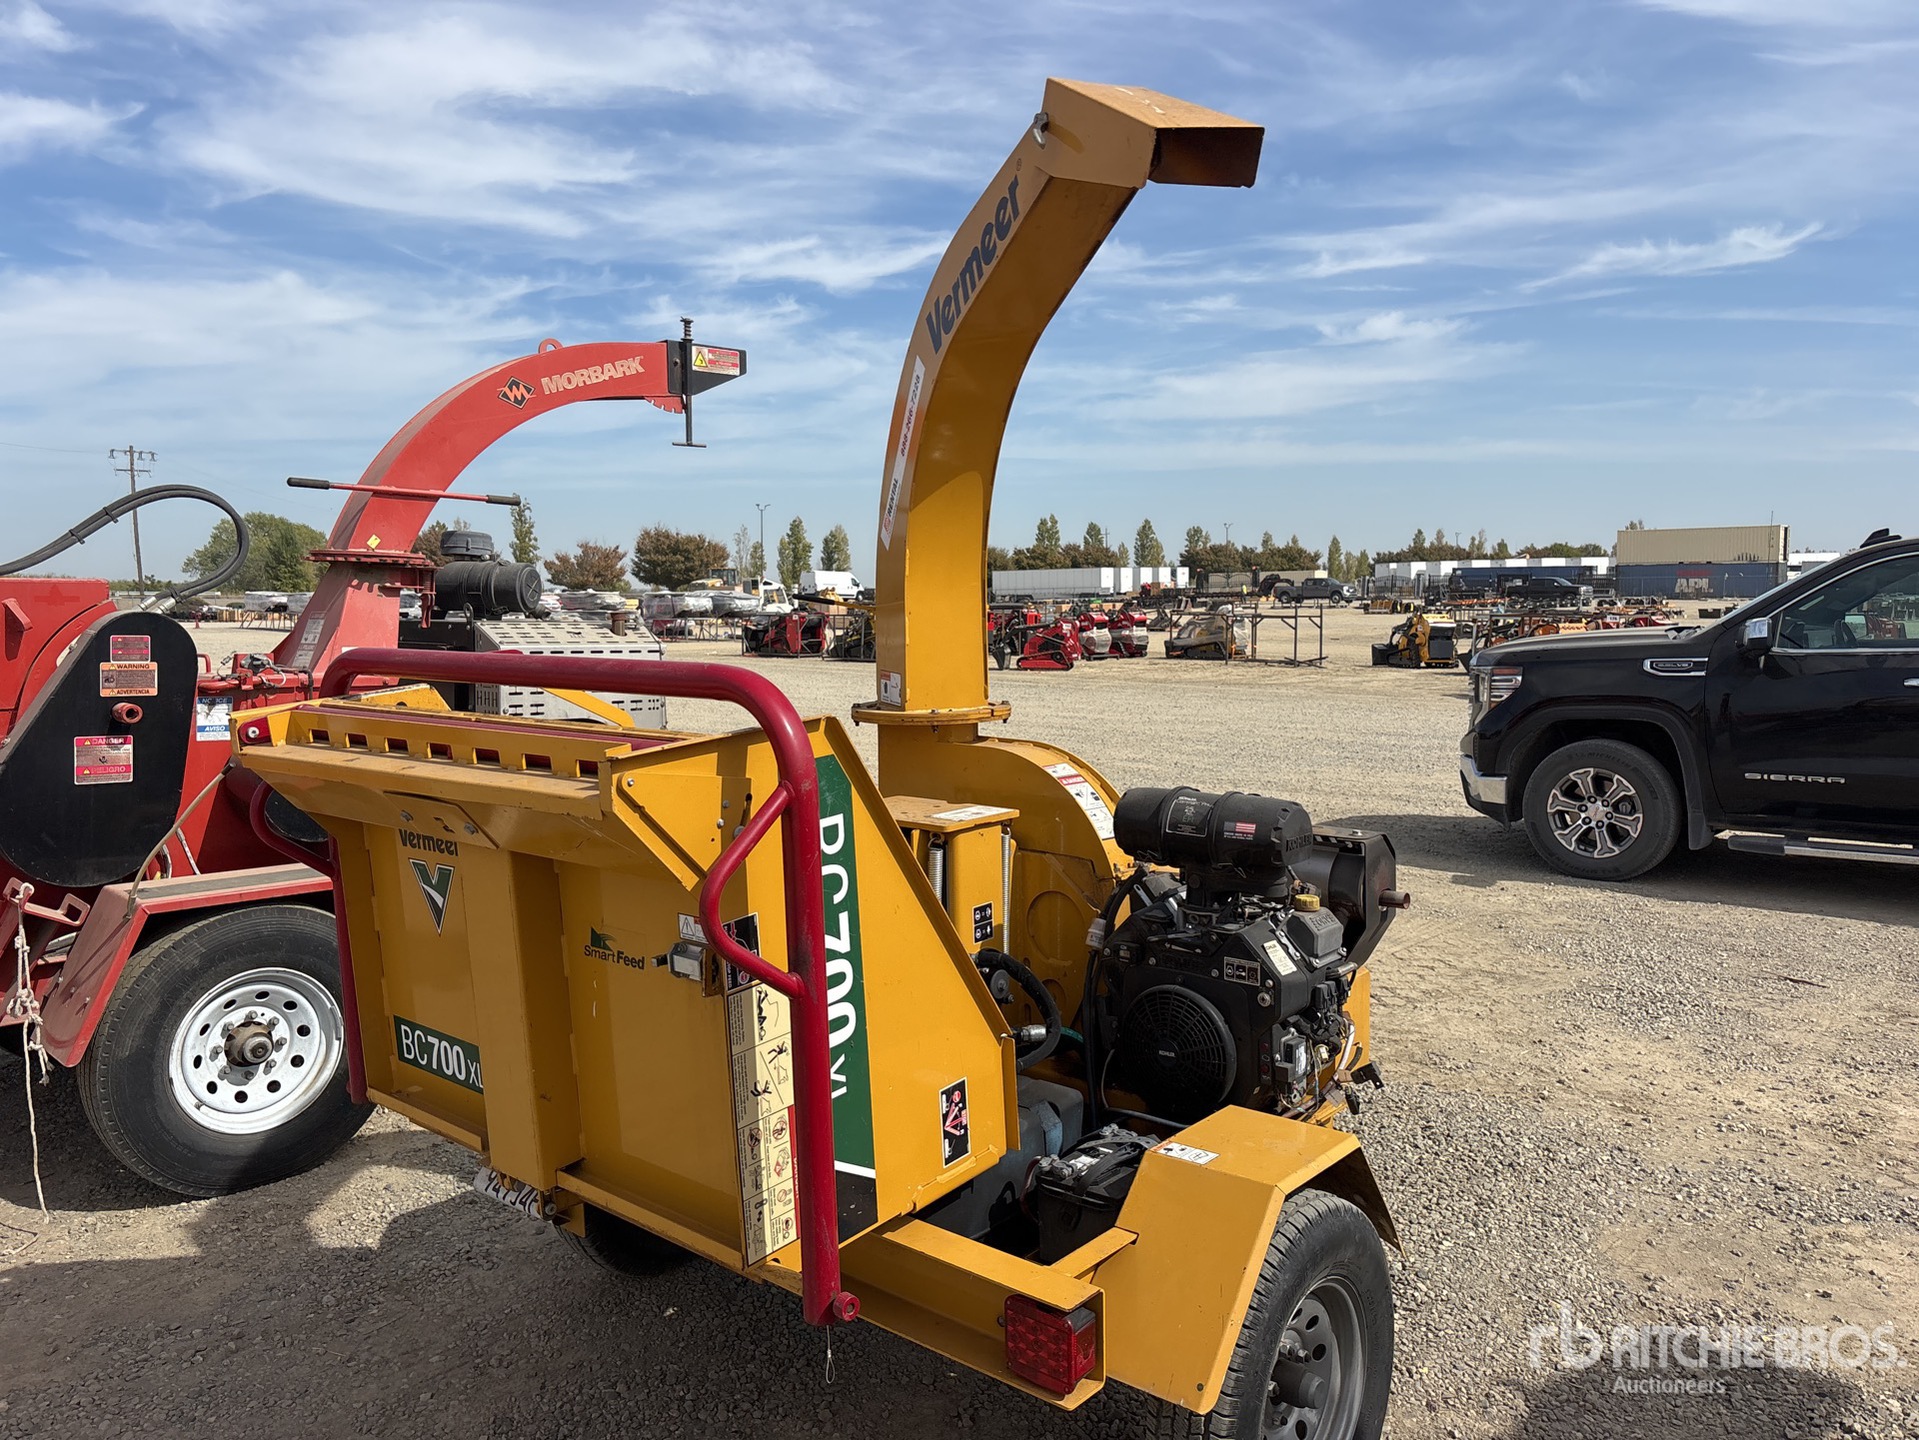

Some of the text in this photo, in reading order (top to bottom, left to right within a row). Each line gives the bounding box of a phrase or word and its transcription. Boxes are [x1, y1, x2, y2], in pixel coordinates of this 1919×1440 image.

[926, 174, 1020, 354] Vermeer
[541, 356, 645, 394] MORBARK
[887, 478, 898, 517] RENTAL
[1744, 772, 1846, 784] SIERRA
[398, 828, 459, 856] Vermeer
